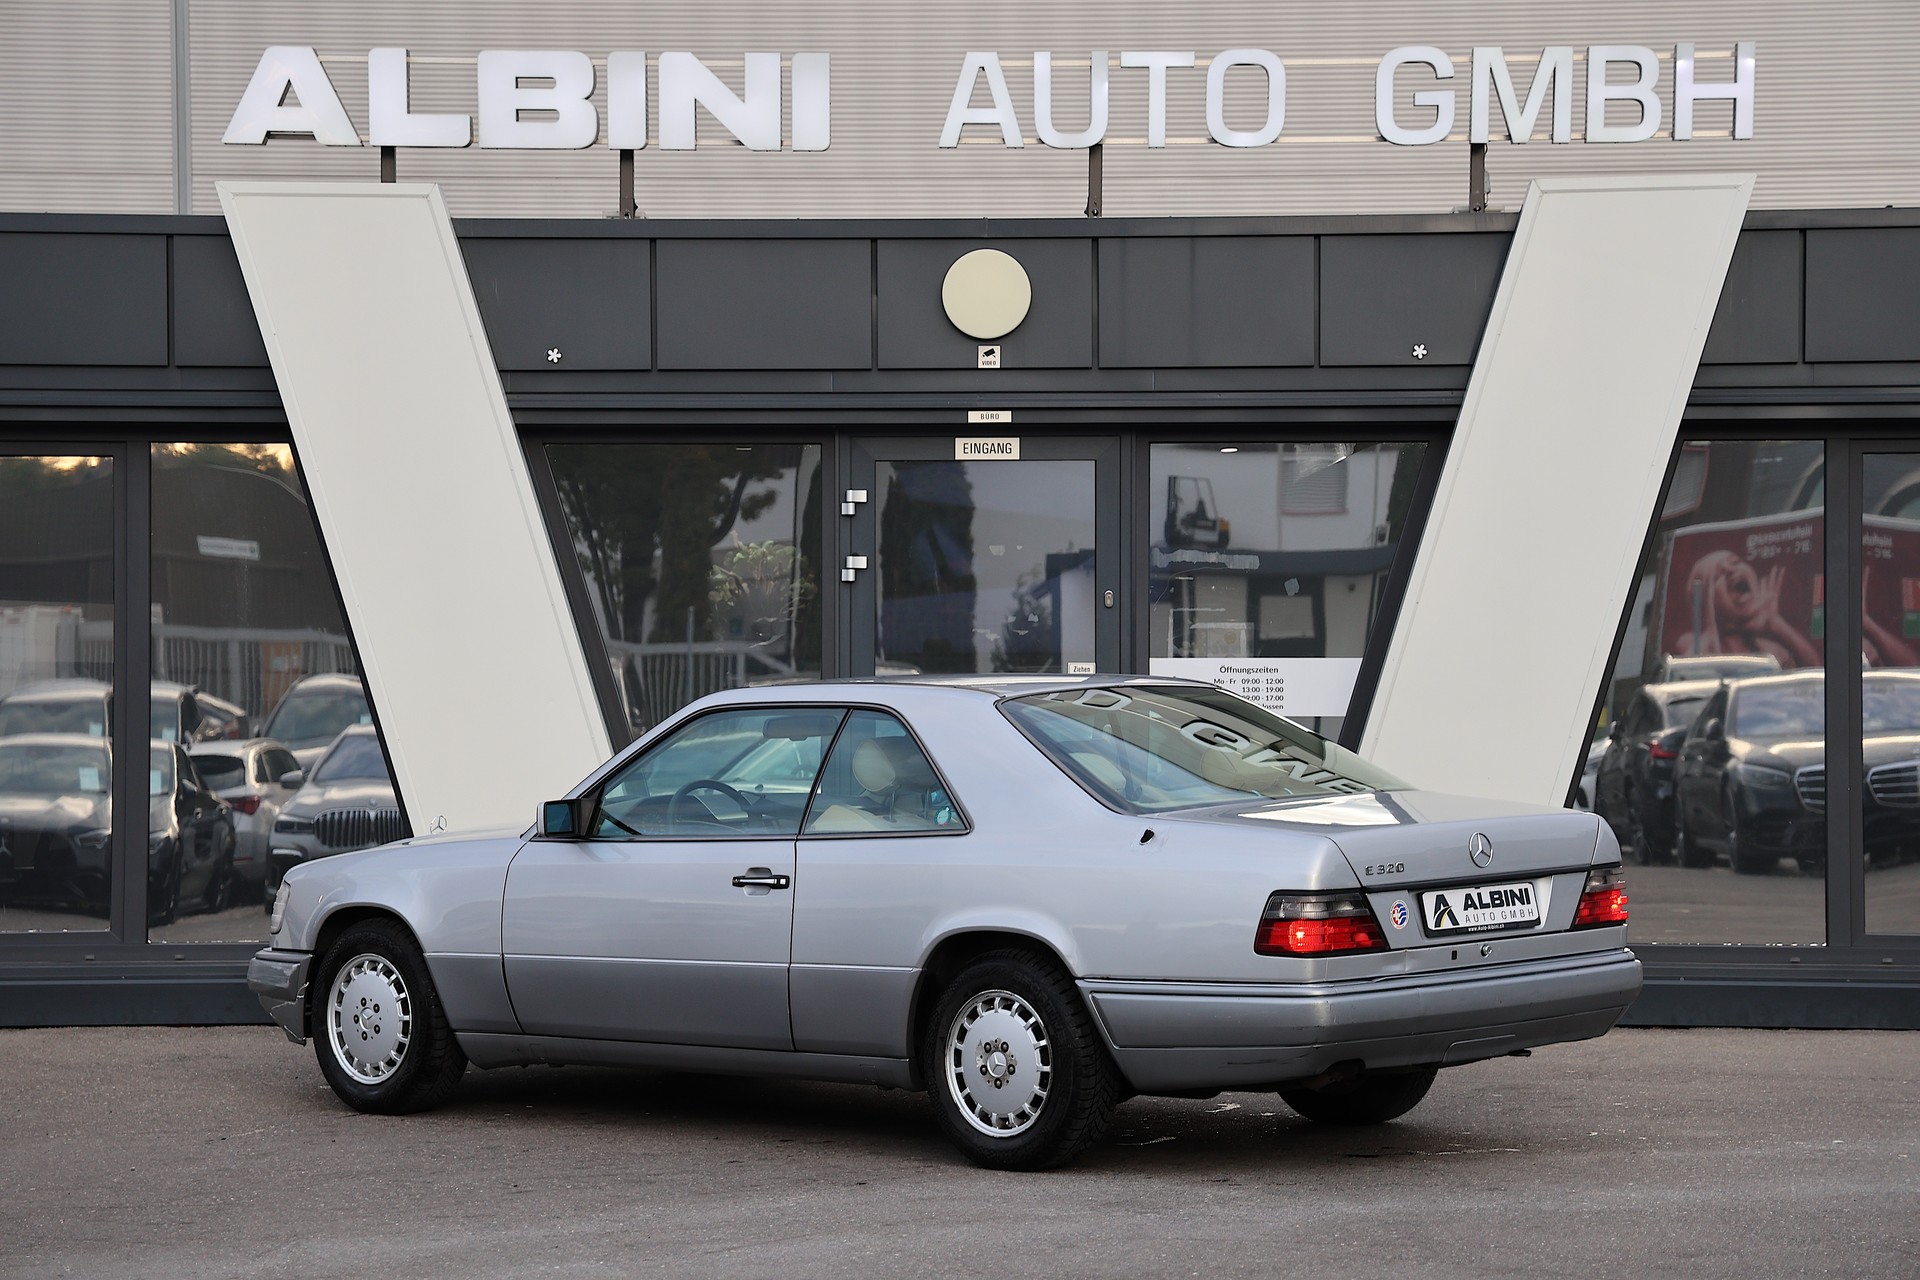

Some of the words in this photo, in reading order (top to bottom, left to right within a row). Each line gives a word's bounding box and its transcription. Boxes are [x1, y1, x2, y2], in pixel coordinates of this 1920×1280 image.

[221, 45, 831, 152] ALBINI
[938, 47, 1286, 150] AUTO
[1375, 41, 1757, 146] GMBH
[980, 412, 1000, 420] BÜRO
[963, 442, 1012, 454] EINGANG
[1219, 665, 1279, 675] Öffnungszeiten
[1365, 865, 1374, 876] E
[1376, 861, 1405, 875] 320
[1463, 887, 1532, 911] ALBINI
[1465, 911, 1496, 924] AUTO
[1501, 908, 1535, 920] GMBH
